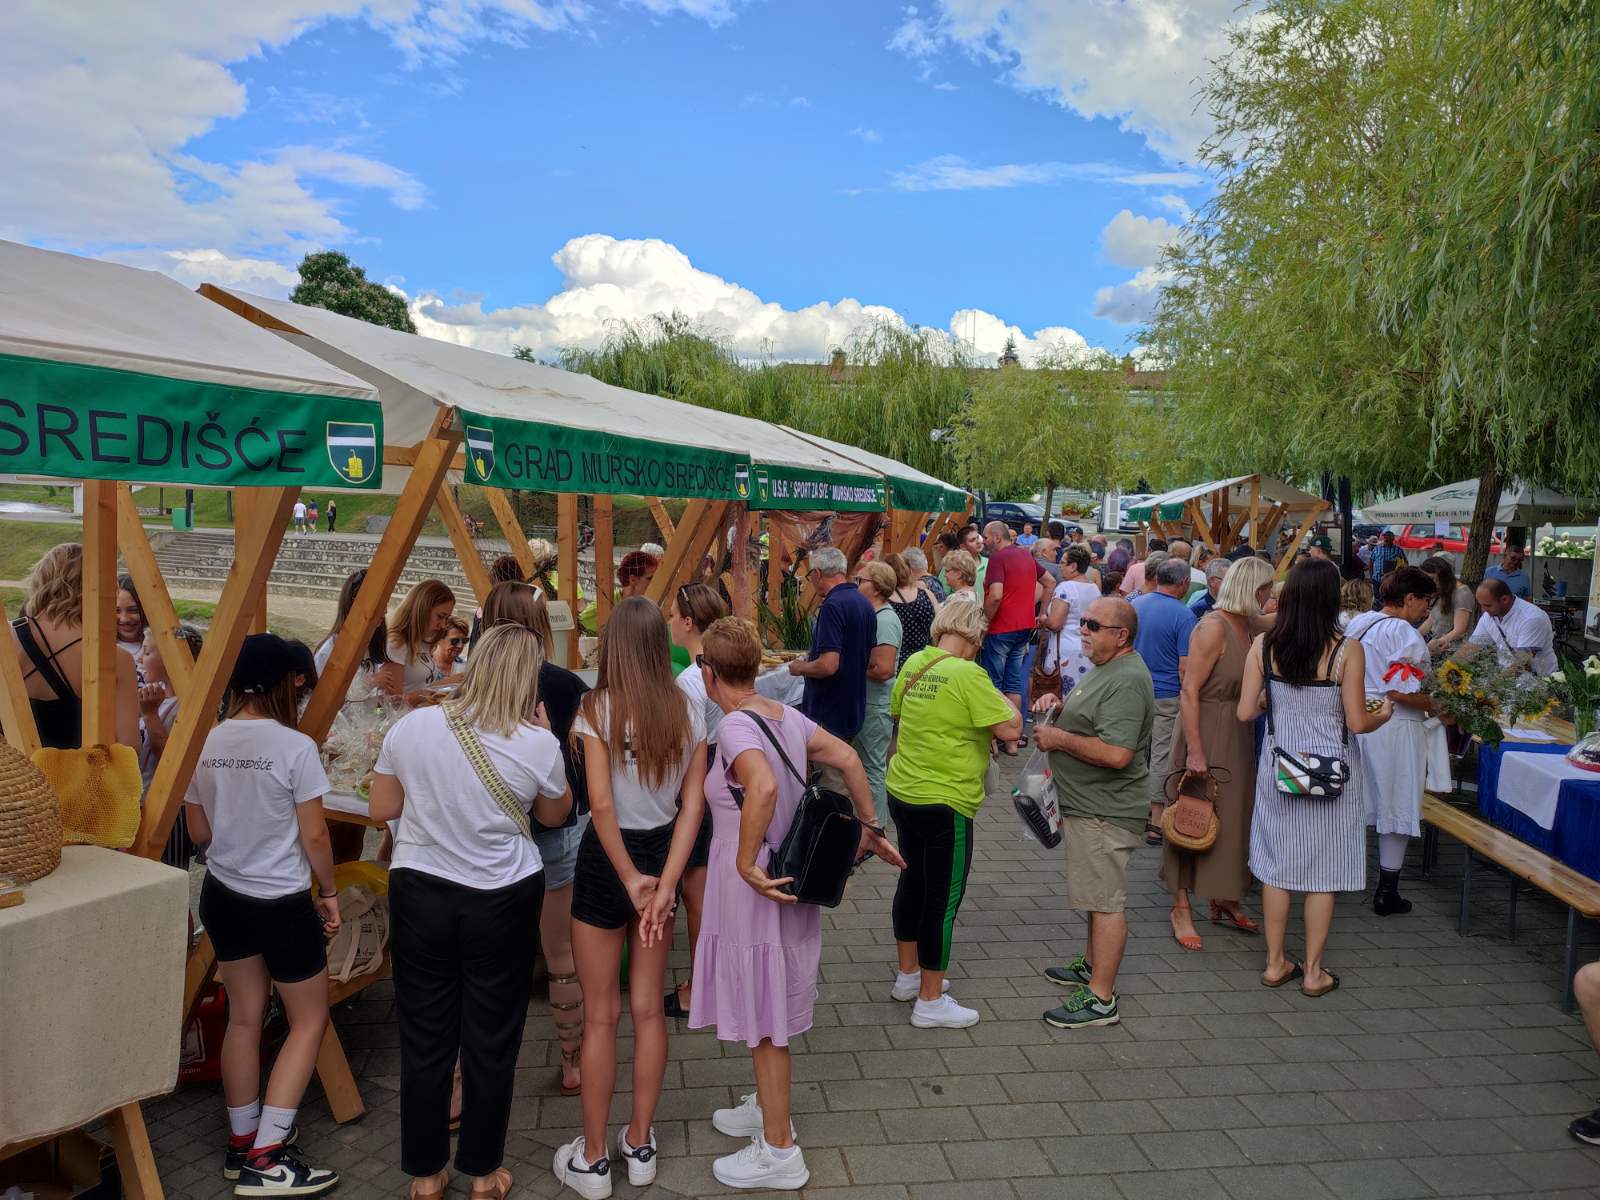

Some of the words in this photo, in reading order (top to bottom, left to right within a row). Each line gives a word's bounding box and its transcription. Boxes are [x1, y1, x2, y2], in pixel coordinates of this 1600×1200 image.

[0, 400, 305, 472] SREDIŠĆE
[504, 442, 573, 482] GRAD
[582, 452, 660, 488] MURSKO
[832, 484, 853, 502] MURSKO
